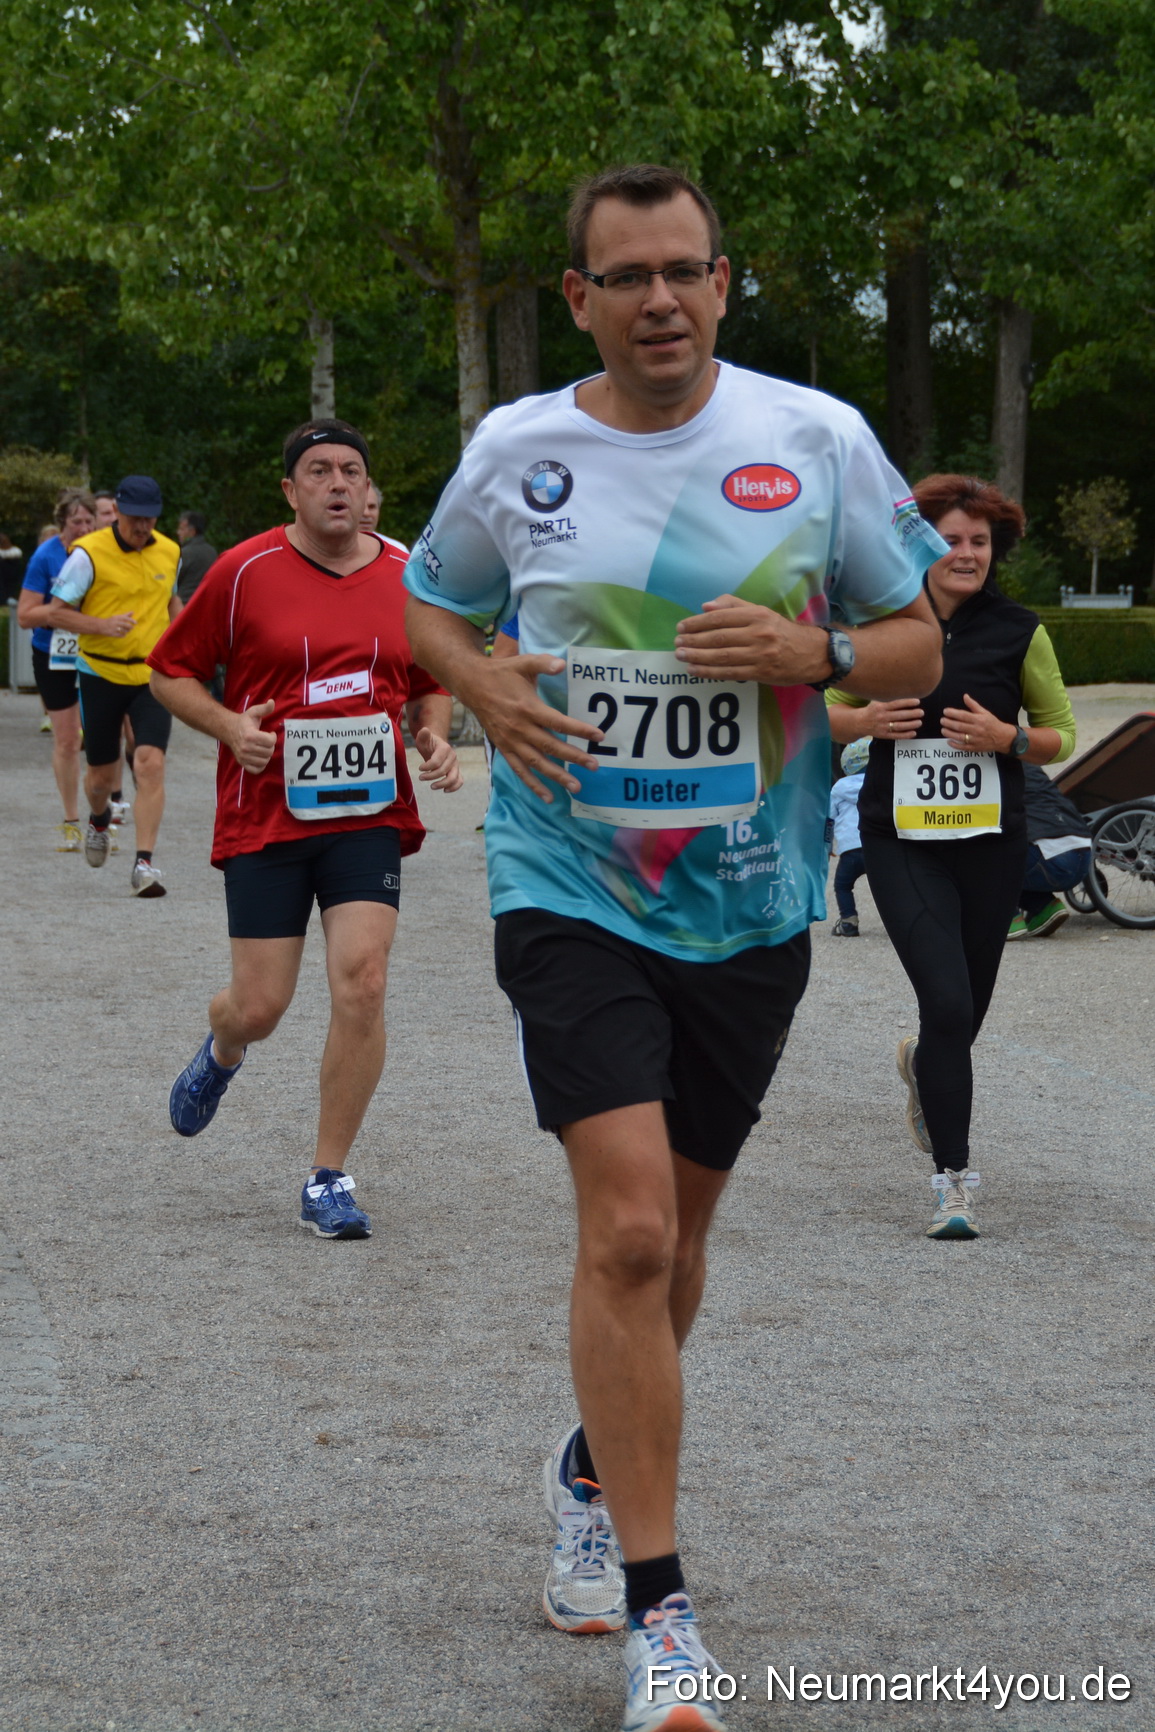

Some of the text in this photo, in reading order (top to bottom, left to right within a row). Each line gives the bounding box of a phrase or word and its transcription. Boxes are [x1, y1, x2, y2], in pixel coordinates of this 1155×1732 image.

[523, 461, 569, 482] BMW
[733, 476, 793, 499] Hervis
[528, 517, 577, 539] PARTL
[531, 531, 577, 549] Neumarkt
[57, 638, 81, 655] 22
[572, 664, 630, 683] PARTL
[326, 680, 353, 694] DEHN
[287, 726, 377, 739] PARTL Neumarkt
[587, 692, 740, 759] 2708
[296, 739, 387, 781] 2494
[897, 749, 930, 759] PARTL
[623, 777, 700, 803] Dieter
[916, 763, 982, 801] 369
[924, 811, 972, 825] Marion
[721, 817, 760, 847] 16.
[719, 837, 782, 864] Neumark
